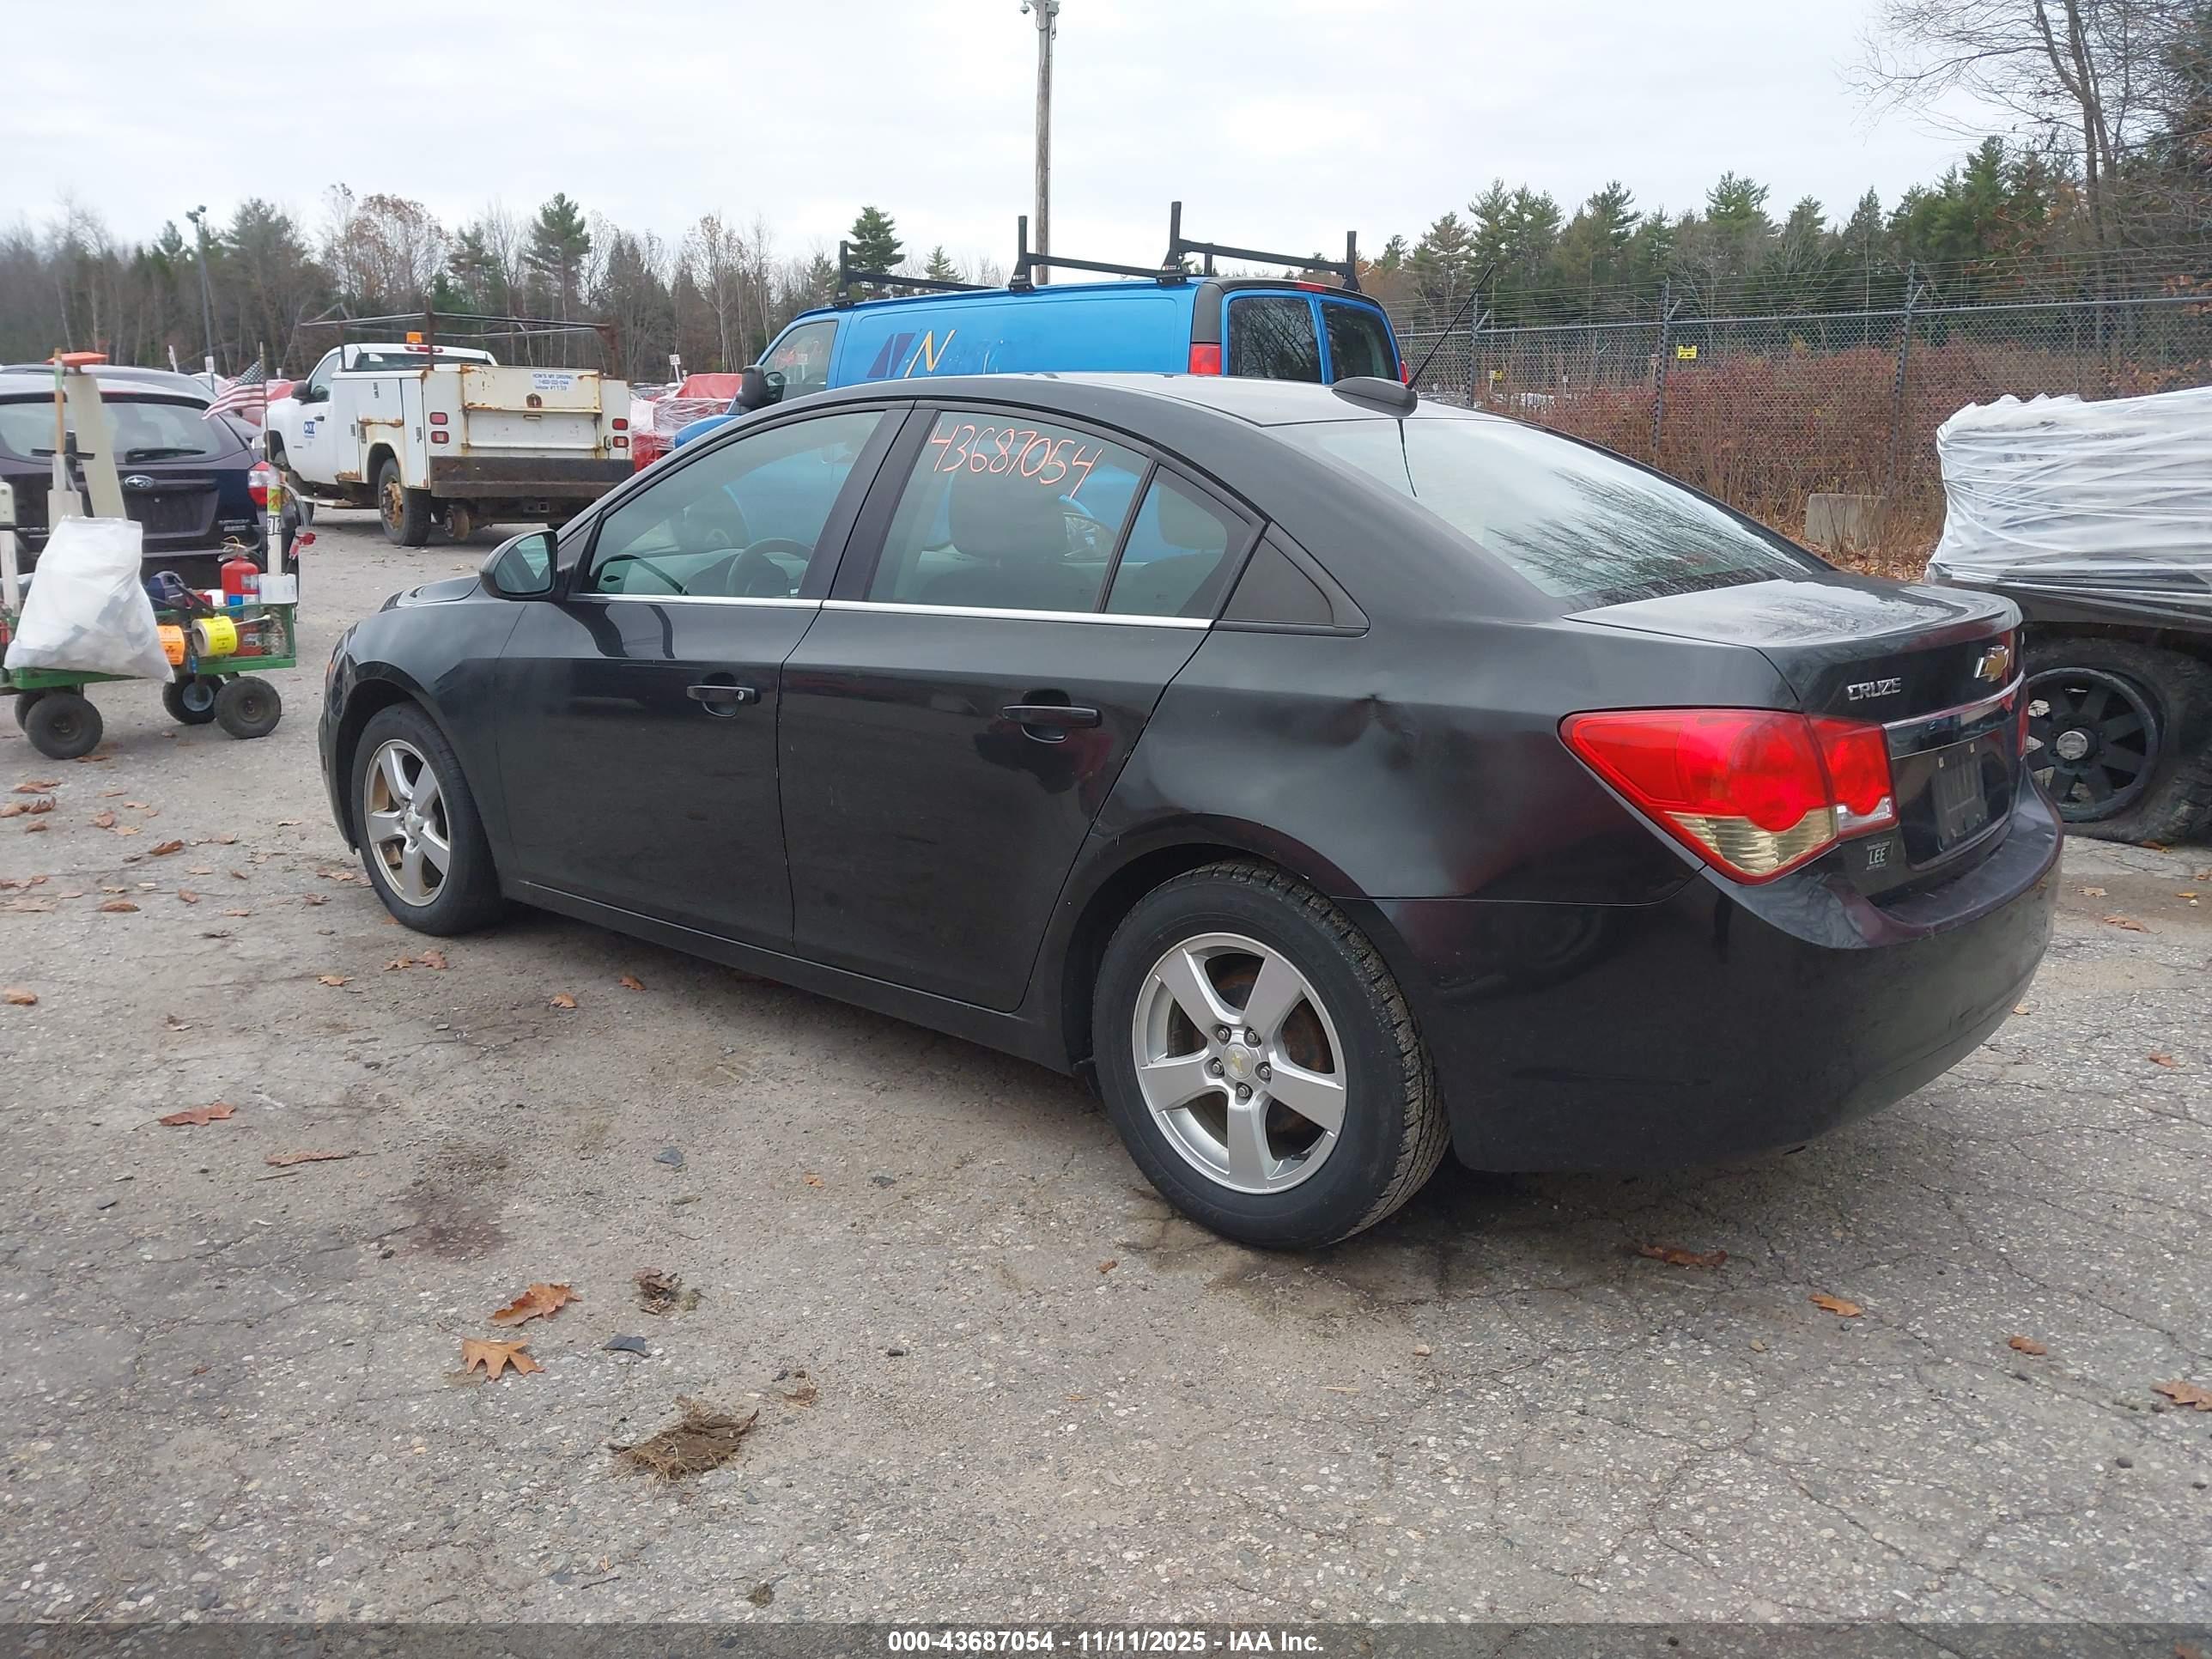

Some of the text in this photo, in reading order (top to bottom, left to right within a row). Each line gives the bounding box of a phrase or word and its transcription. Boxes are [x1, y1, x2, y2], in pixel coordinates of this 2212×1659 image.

[931, 421, 1103, 501] 43687054
[1847, 677, 1902, 702] CRUZE
[1869, 847, 1887, 866] LEE
